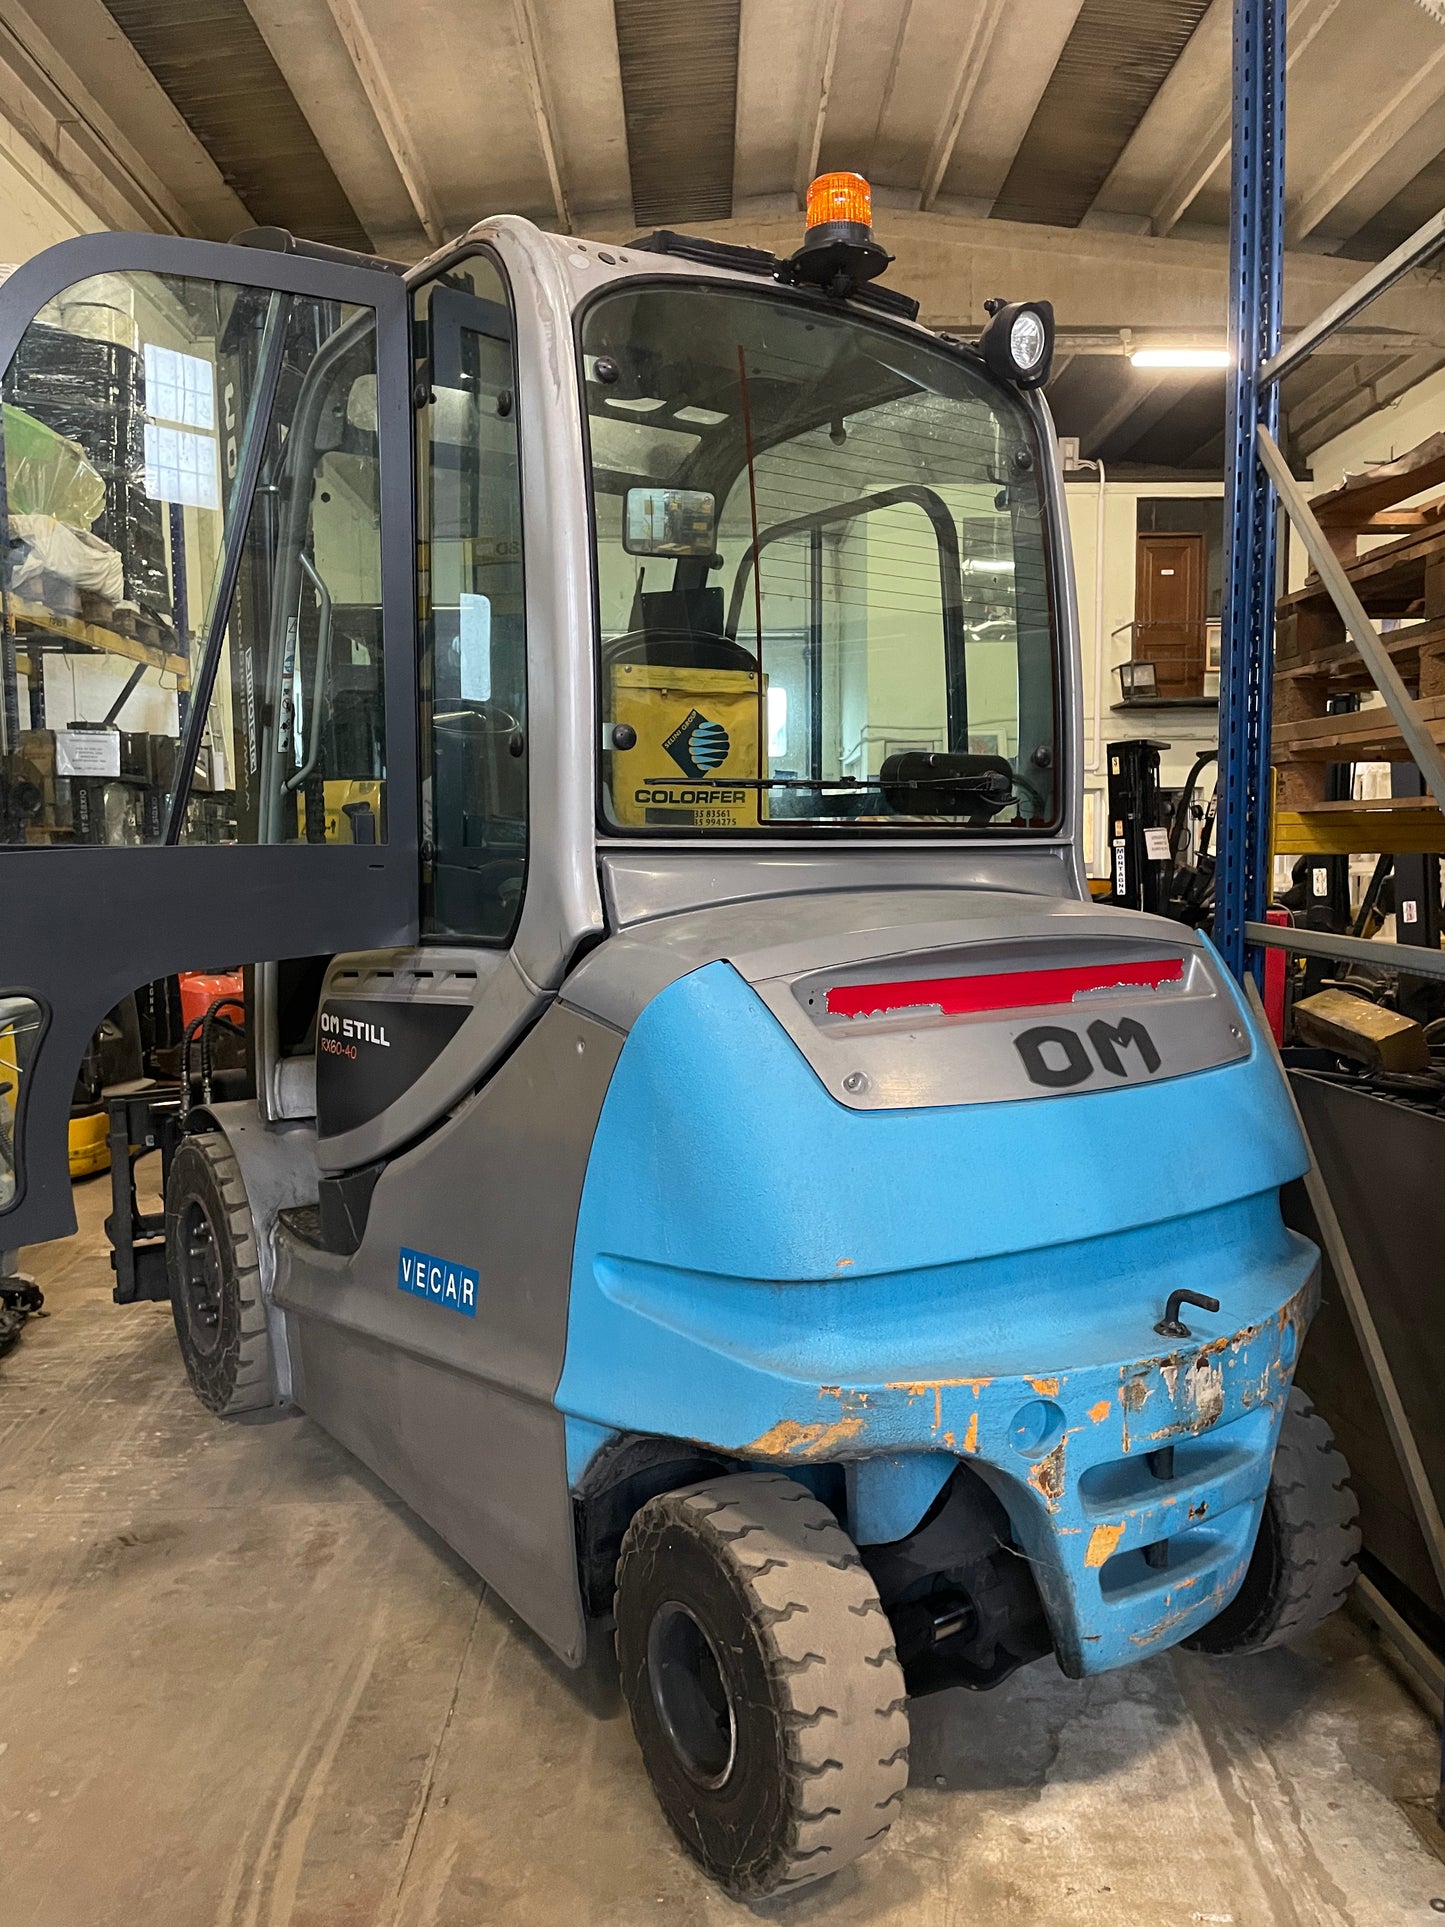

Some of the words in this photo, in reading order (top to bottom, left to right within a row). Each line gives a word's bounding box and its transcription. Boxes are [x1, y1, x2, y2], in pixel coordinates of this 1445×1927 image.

[224, 382, 237, 480] OM
[664, 729, 682, 749] SELINI
[635, 789, 746, 804] COLORFER
[706, 809, 730, 818] 83561
[1116, 848, 1125, 894] MONTAGNA
[320, 1012, 340, 1034] OM
[342, 1018, 391, 1048] STILL
[320, 1037, 358, 1060] RX60-40
[1013, 1017, 1162, 1088] OM
[401, 1256, 475, 1307] VECAR
